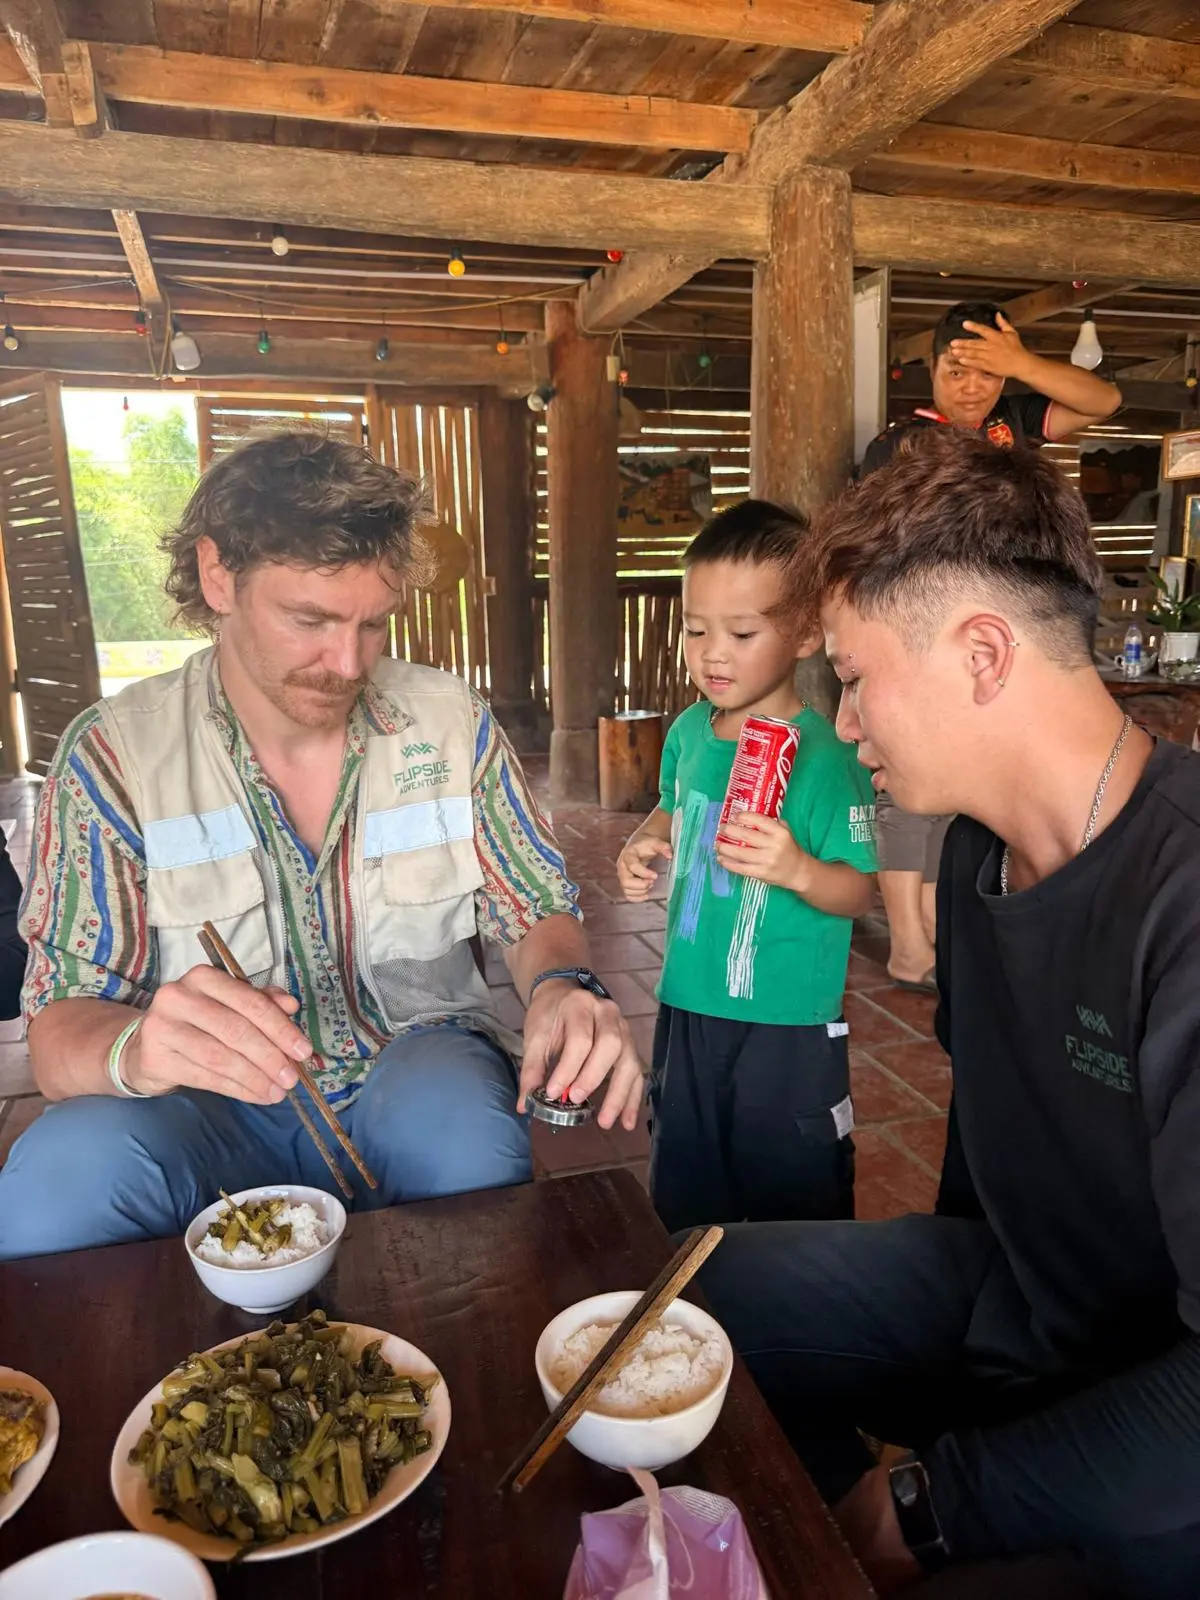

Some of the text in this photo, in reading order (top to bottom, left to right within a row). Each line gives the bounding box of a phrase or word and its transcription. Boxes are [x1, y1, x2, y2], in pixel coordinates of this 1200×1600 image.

[393, 760, 452, 786] FLIPSIDE
[399, 775, 450, 796] ADVENTURES
[1065, 1034, 1133, 1079] FLIPSIDE
